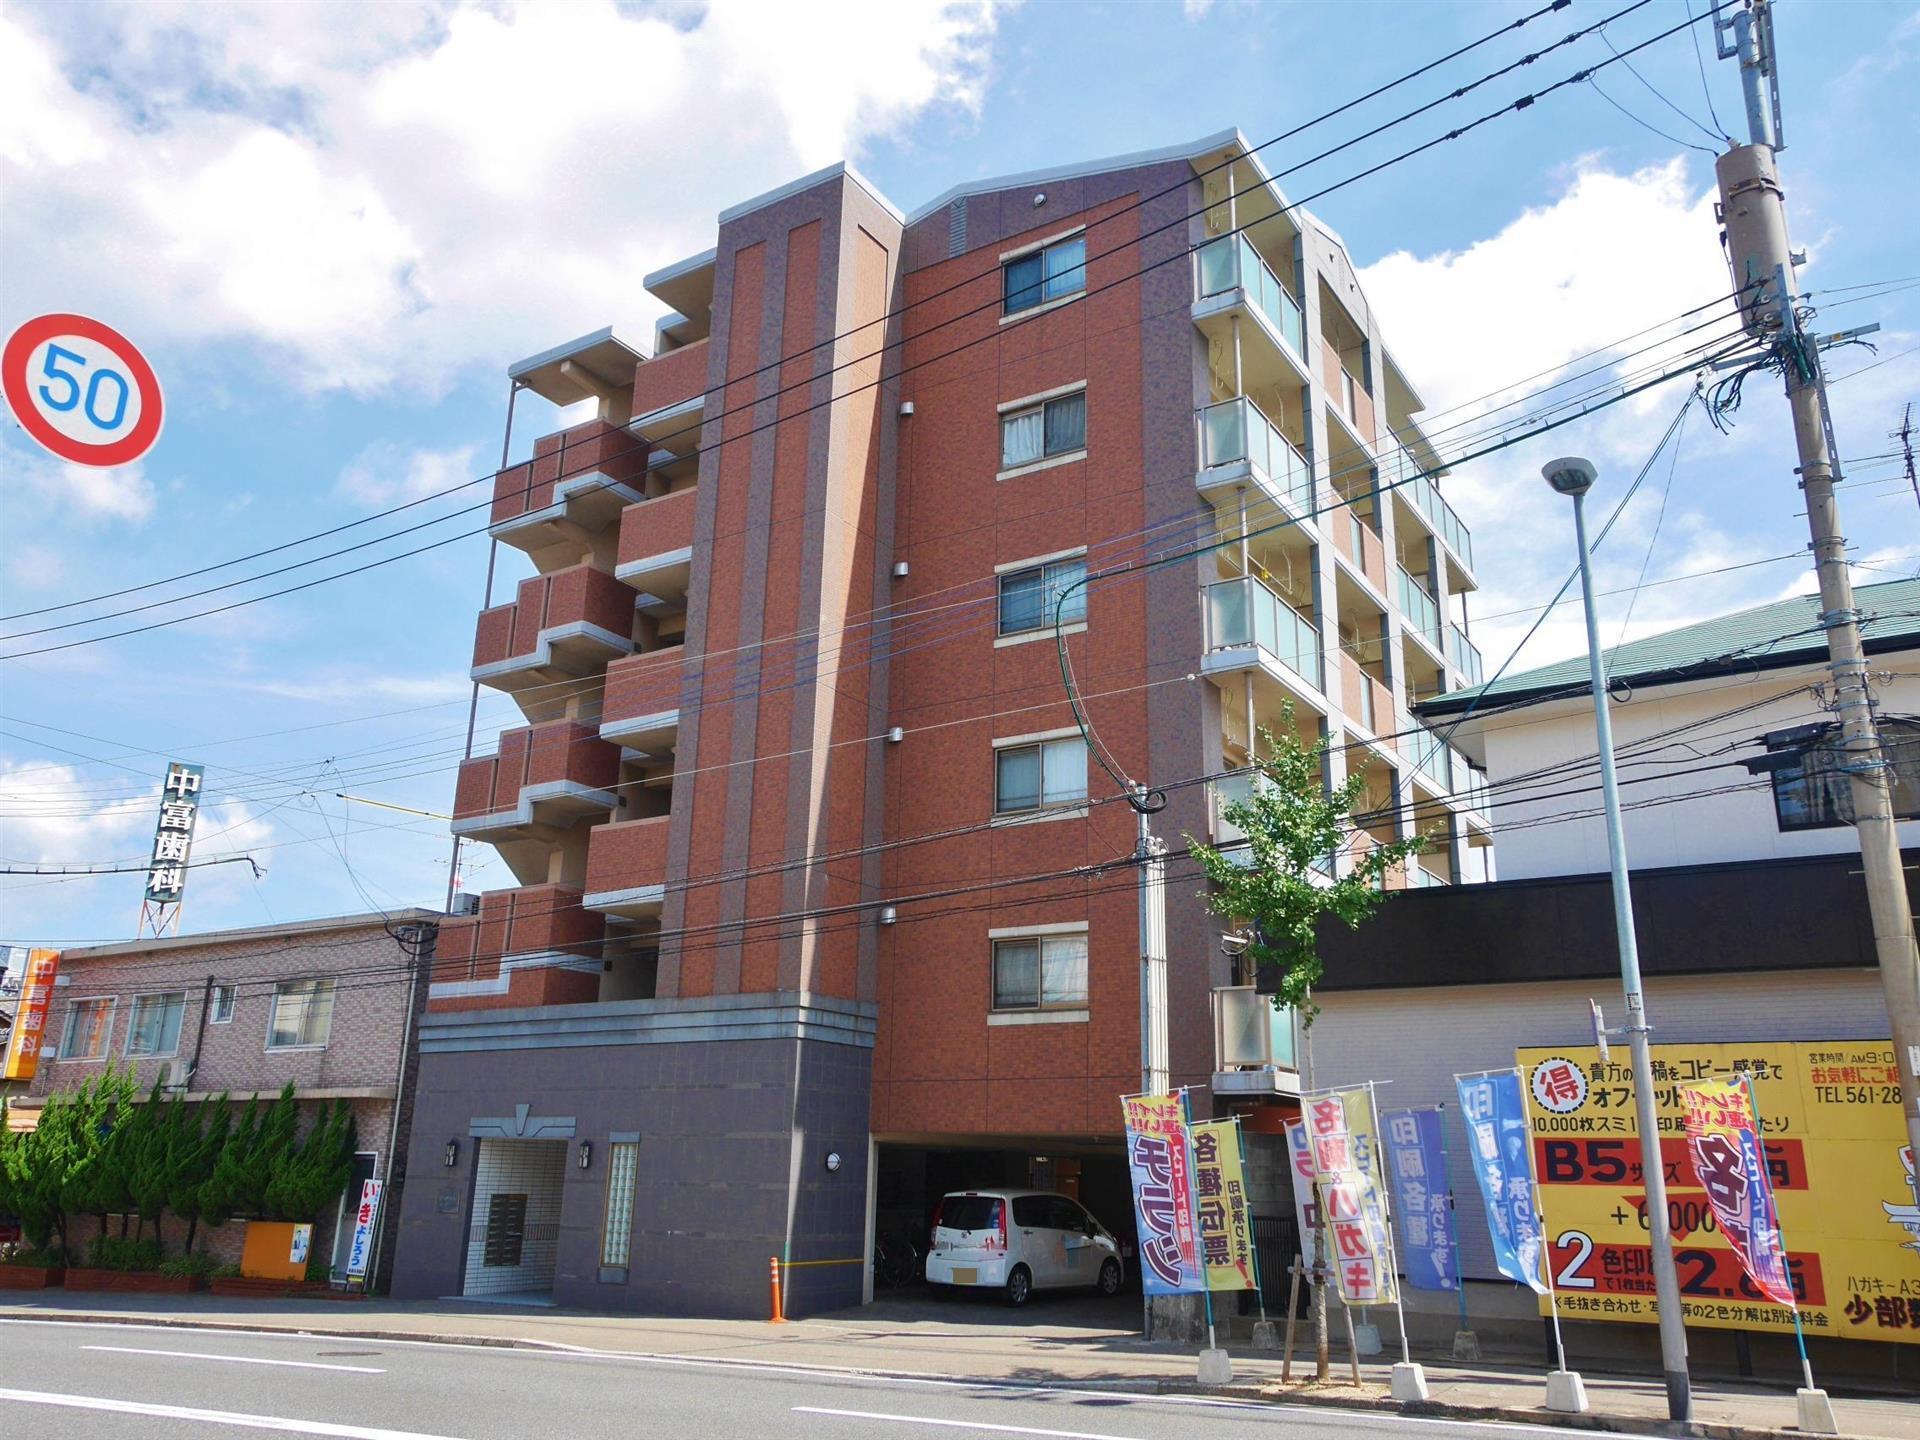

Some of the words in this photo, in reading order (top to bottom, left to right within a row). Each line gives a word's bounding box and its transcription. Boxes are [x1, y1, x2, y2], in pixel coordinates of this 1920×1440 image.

[39, 343, 129, 430] 50
[148, 769, 200, 893] 中富歯科
[15, 958, 54, 1057] 中富歯科
[1539, 1064, 1579, 1105] 得
[1589, 1060, 1783, 1082] 貴方の稿をコピー感覚で
[1593, 1086, 1680, 1107] オフット
[1815, 1087, 1844, 1103] TEL
[1847, 1087, 1903, 1104] 561-28
[1601, 1248, 1655, 1276] 色印
